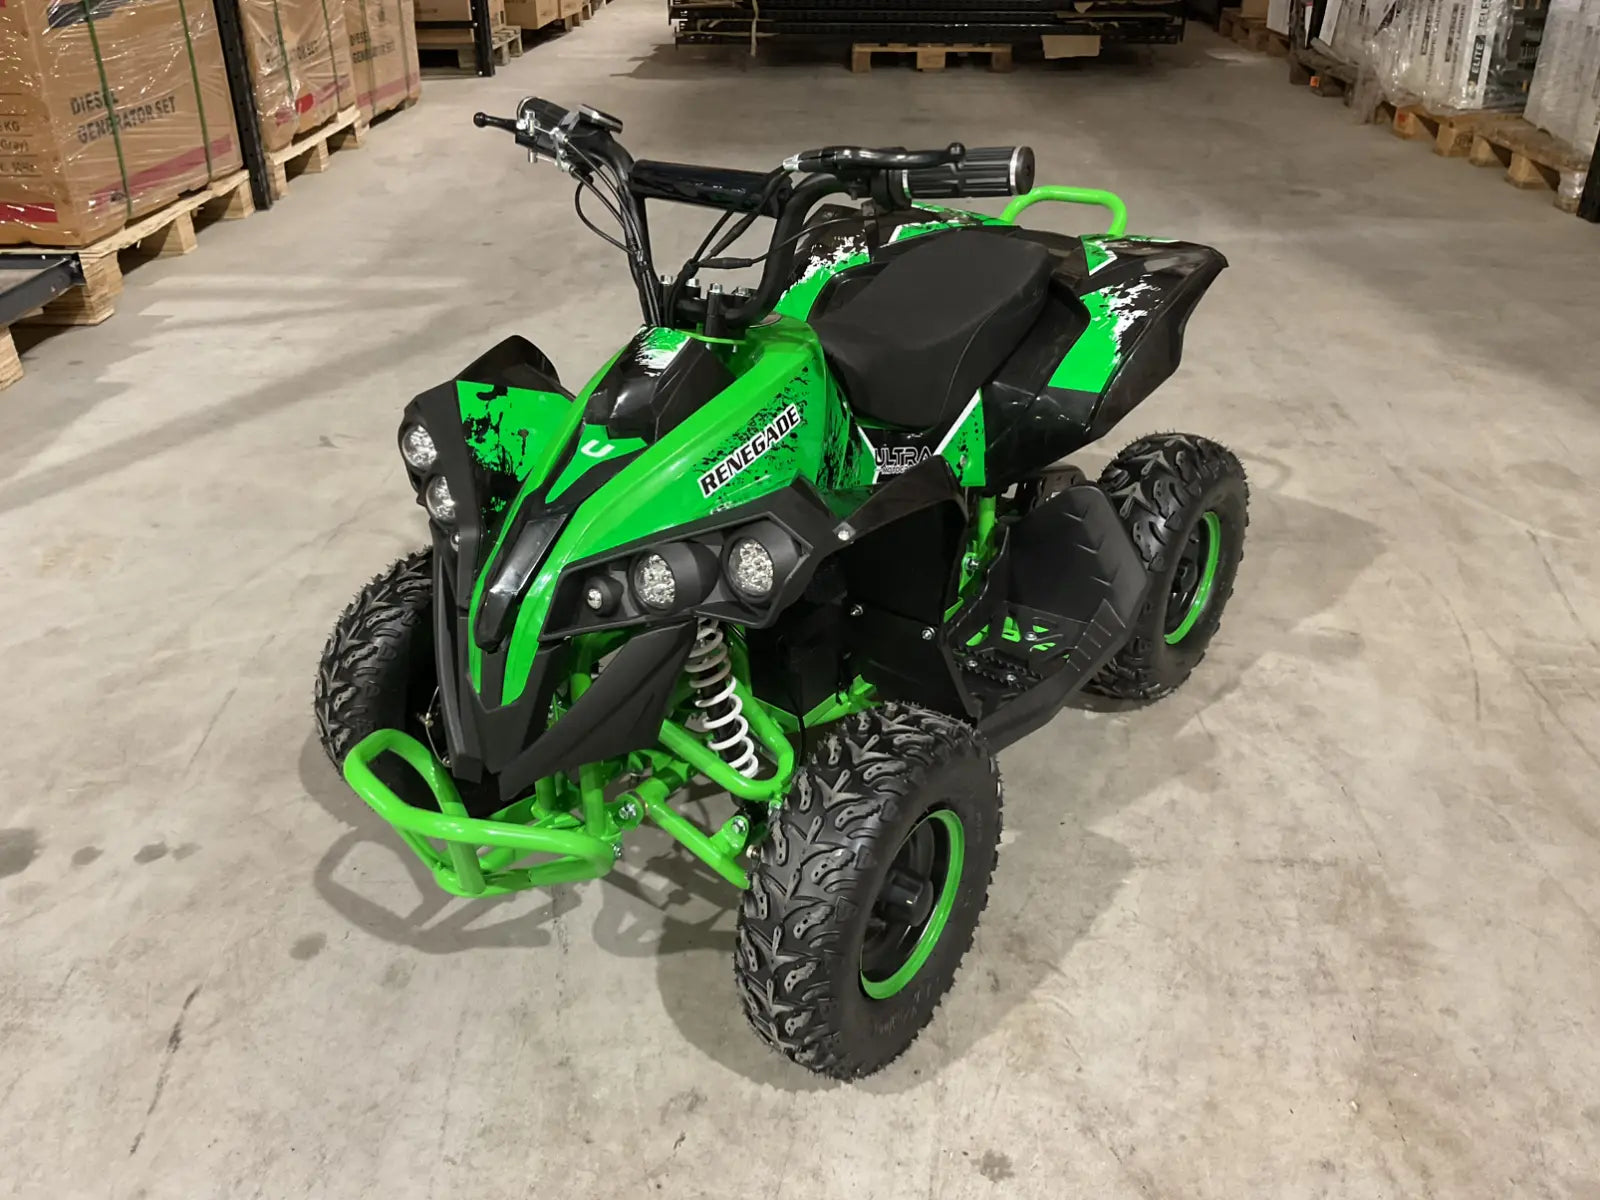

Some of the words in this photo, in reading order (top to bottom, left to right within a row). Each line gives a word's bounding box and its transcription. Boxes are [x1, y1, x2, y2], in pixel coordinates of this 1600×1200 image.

[1471, 42, 1484, 74] ELITE
[70, 91, 119, 115] DIESL
[155, 96, 176, 115] SET
[697, 403, 800, 498] RENEGADE
[875, 446, 932, 467] ULTRA
